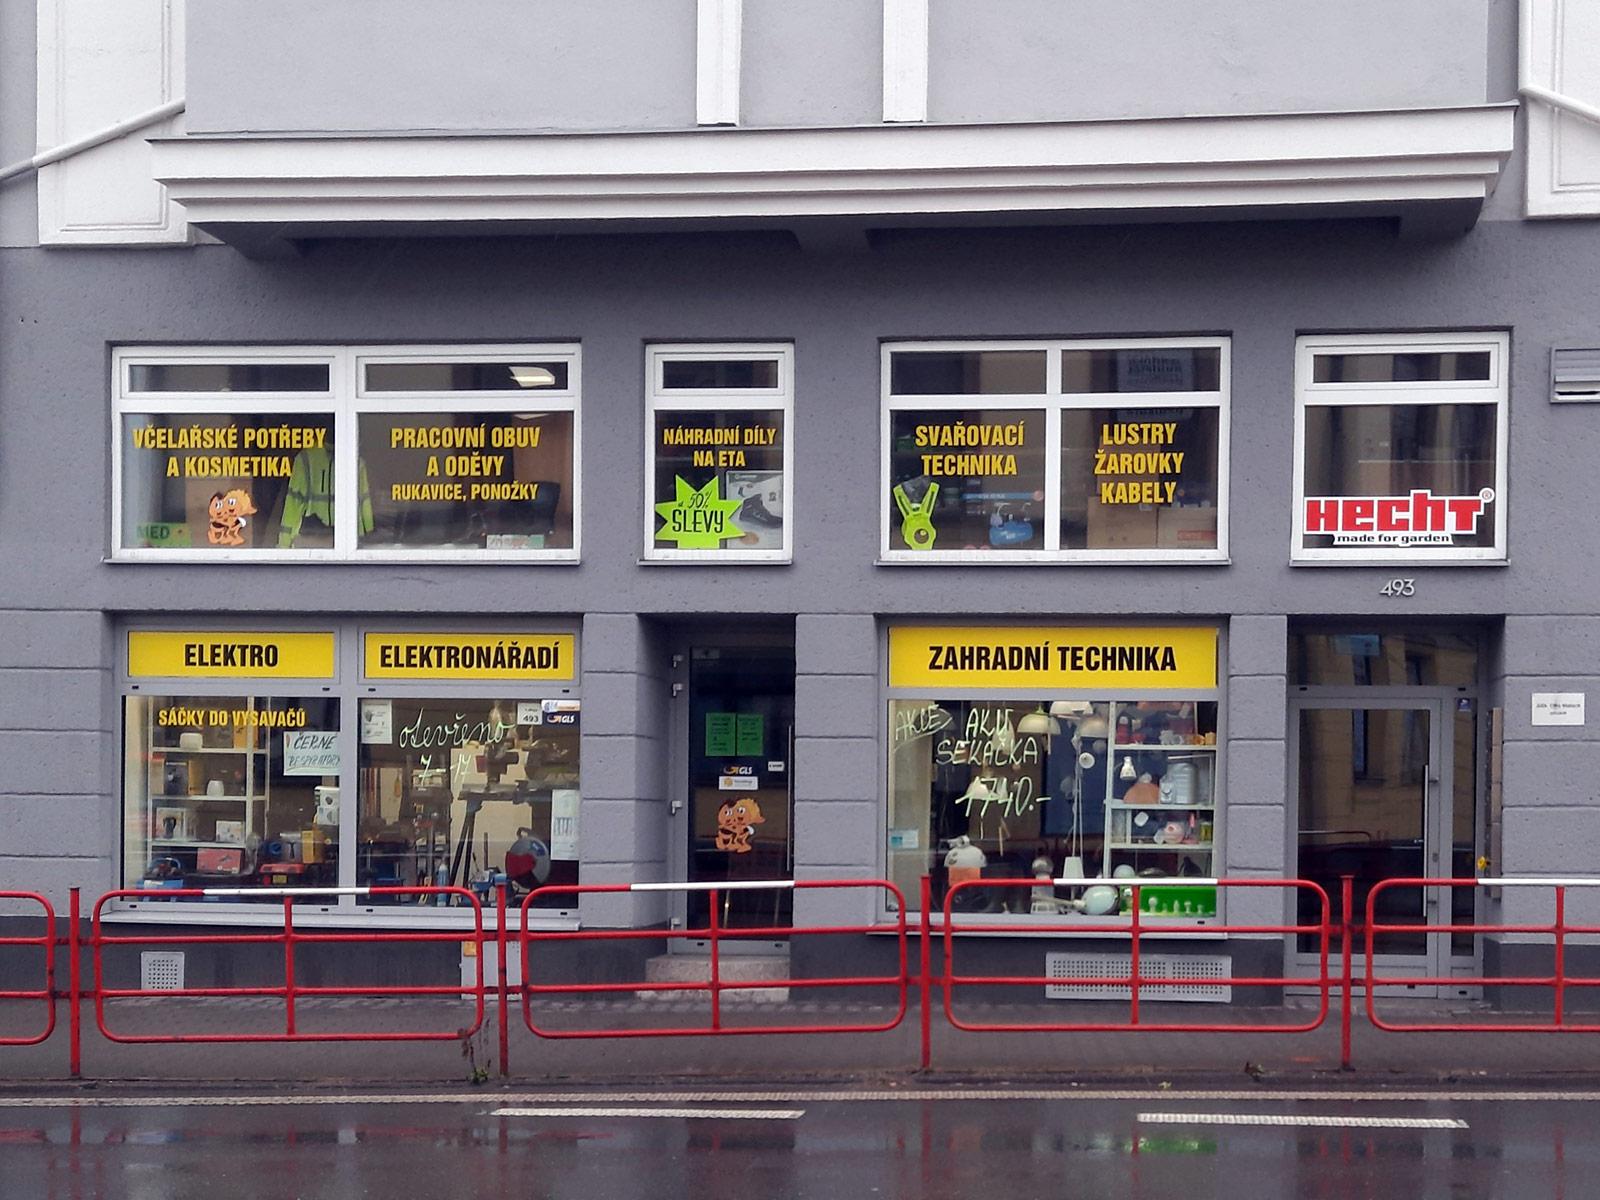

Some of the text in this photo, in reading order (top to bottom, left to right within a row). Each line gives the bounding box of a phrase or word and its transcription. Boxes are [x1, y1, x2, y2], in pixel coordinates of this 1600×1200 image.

[132, 423, 327, 449] VČELAŘSKÉ POTŘEBY
[391, 423, 541, 448] PRACOVNÍ OBUV
[663, 426, 777, 445] NÁHRADNÍ DÍLY
[915, 421, 1025, 447] SVAŘOVACÍ
[1102, 423, 1177, 446] LUSTRY
[166, 456, 293, 478] A KOSMETIKA
[426, 452, 504, 477] A ODĚVY
[693, 451, 746, 467] NA ETA
[921, 454, 1017, 476] TECHNIKA
[1094, 448, 1185, 475] ŽAROVKY
[391, 480, 538, 502] RUKAVICE, PONOŽKY
[1101, 481, 1177, 504] KABELY
[672, 508, 724, 534] SLEVY
[1337, 533, 1450, 545] made for garden
[1379, 578, 1415, 597] 493
[184, 643, 279, 668] ELEKTRO
[380, 640, 560, 670] ELEKTRONÁŘADÍ
[928, 640, 1177, 671] ZAHRADNÍ TECHNIKA
[158, 706, 307, 728] SÁČKY DO VYSAVAČŮ
[399, 707, 516, 749] otevřeno
[561, 715, 575, 724] GLS
[935, 736, 1038, 766] SEKAČKA
[739, 766, 753, 775] GLS
